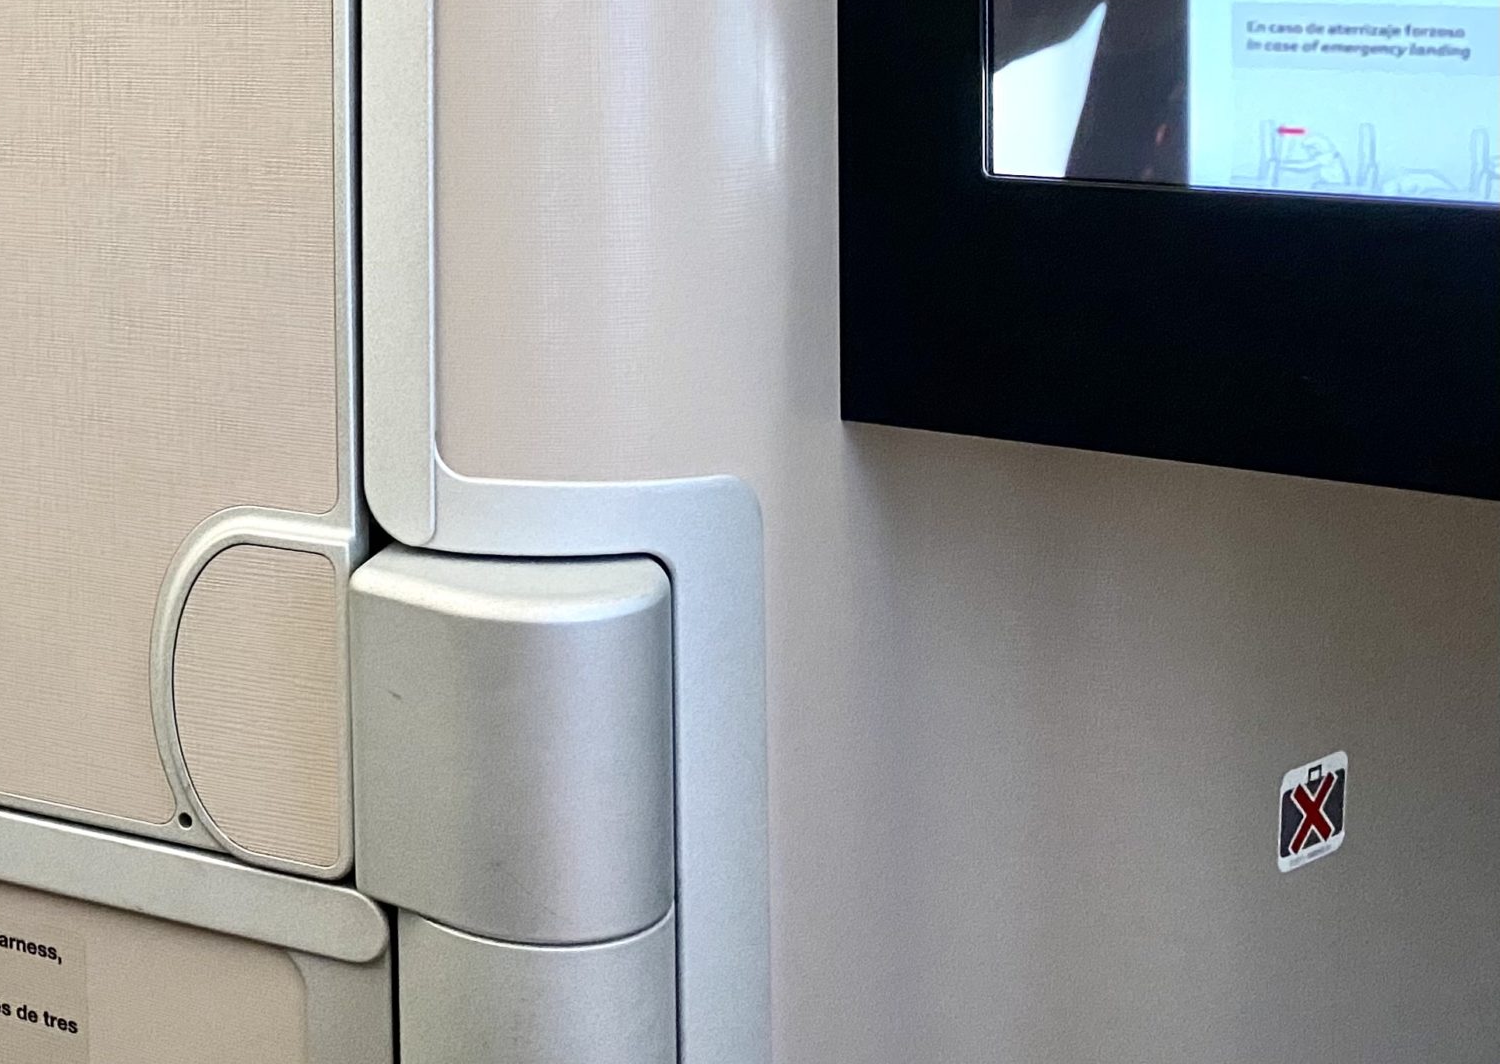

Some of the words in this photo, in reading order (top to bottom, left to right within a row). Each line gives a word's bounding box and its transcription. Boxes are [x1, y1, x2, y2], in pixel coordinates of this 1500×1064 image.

[1246, 20, 1266, 34] En
[1269, 22, 1303, 34] caso
[1305, 22, 1325, 35] de
[1327, 24, 1402, 39] aterrizaje
[1246, 38, 1262, 50] In
[1264, 40, 1298, 52] case
[1302, 39, 1320, 52] of
[1320, 43, 1407, 58] emergency
[1409, 43, 1471, 61] landing
[16, 1004, 39, 1023] de
[43, 1011, 79, 1035] tres
